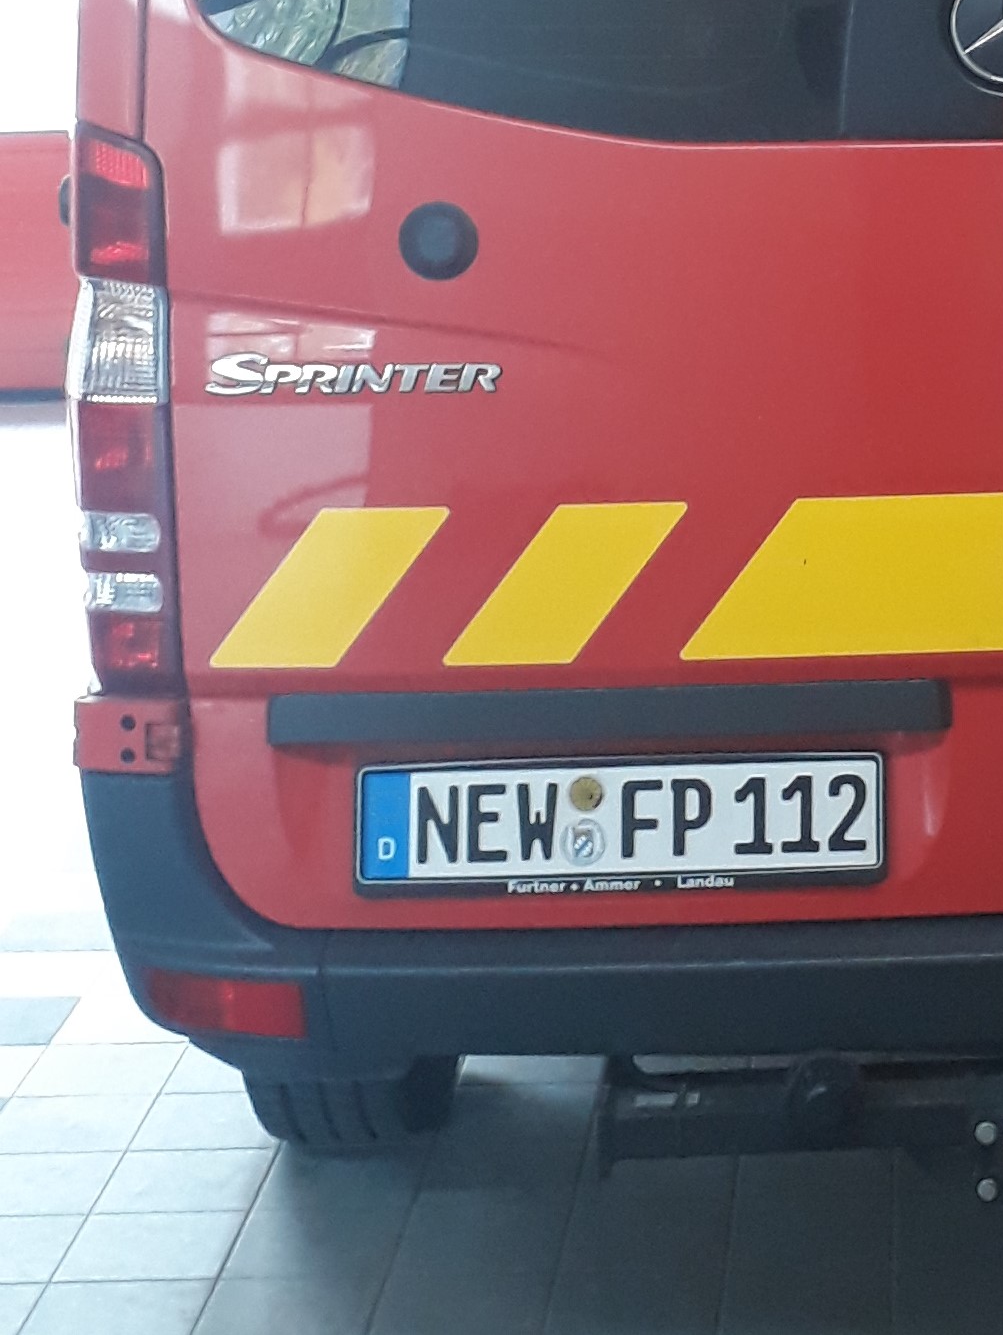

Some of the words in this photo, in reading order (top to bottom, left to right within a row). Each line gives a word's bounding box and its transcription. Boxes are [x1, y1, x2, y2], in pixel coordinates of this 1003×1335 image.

[377, 836, 397, 862] D
[415, 782, 558, 865] NEW
[620, 776, 713, 859] FP
[732, 773, 868, 855] 112
[507, 878, 566, 894] Furtner
[582, 877, 642, 893] Ammer
[676, 874, 735, 889] Landau
